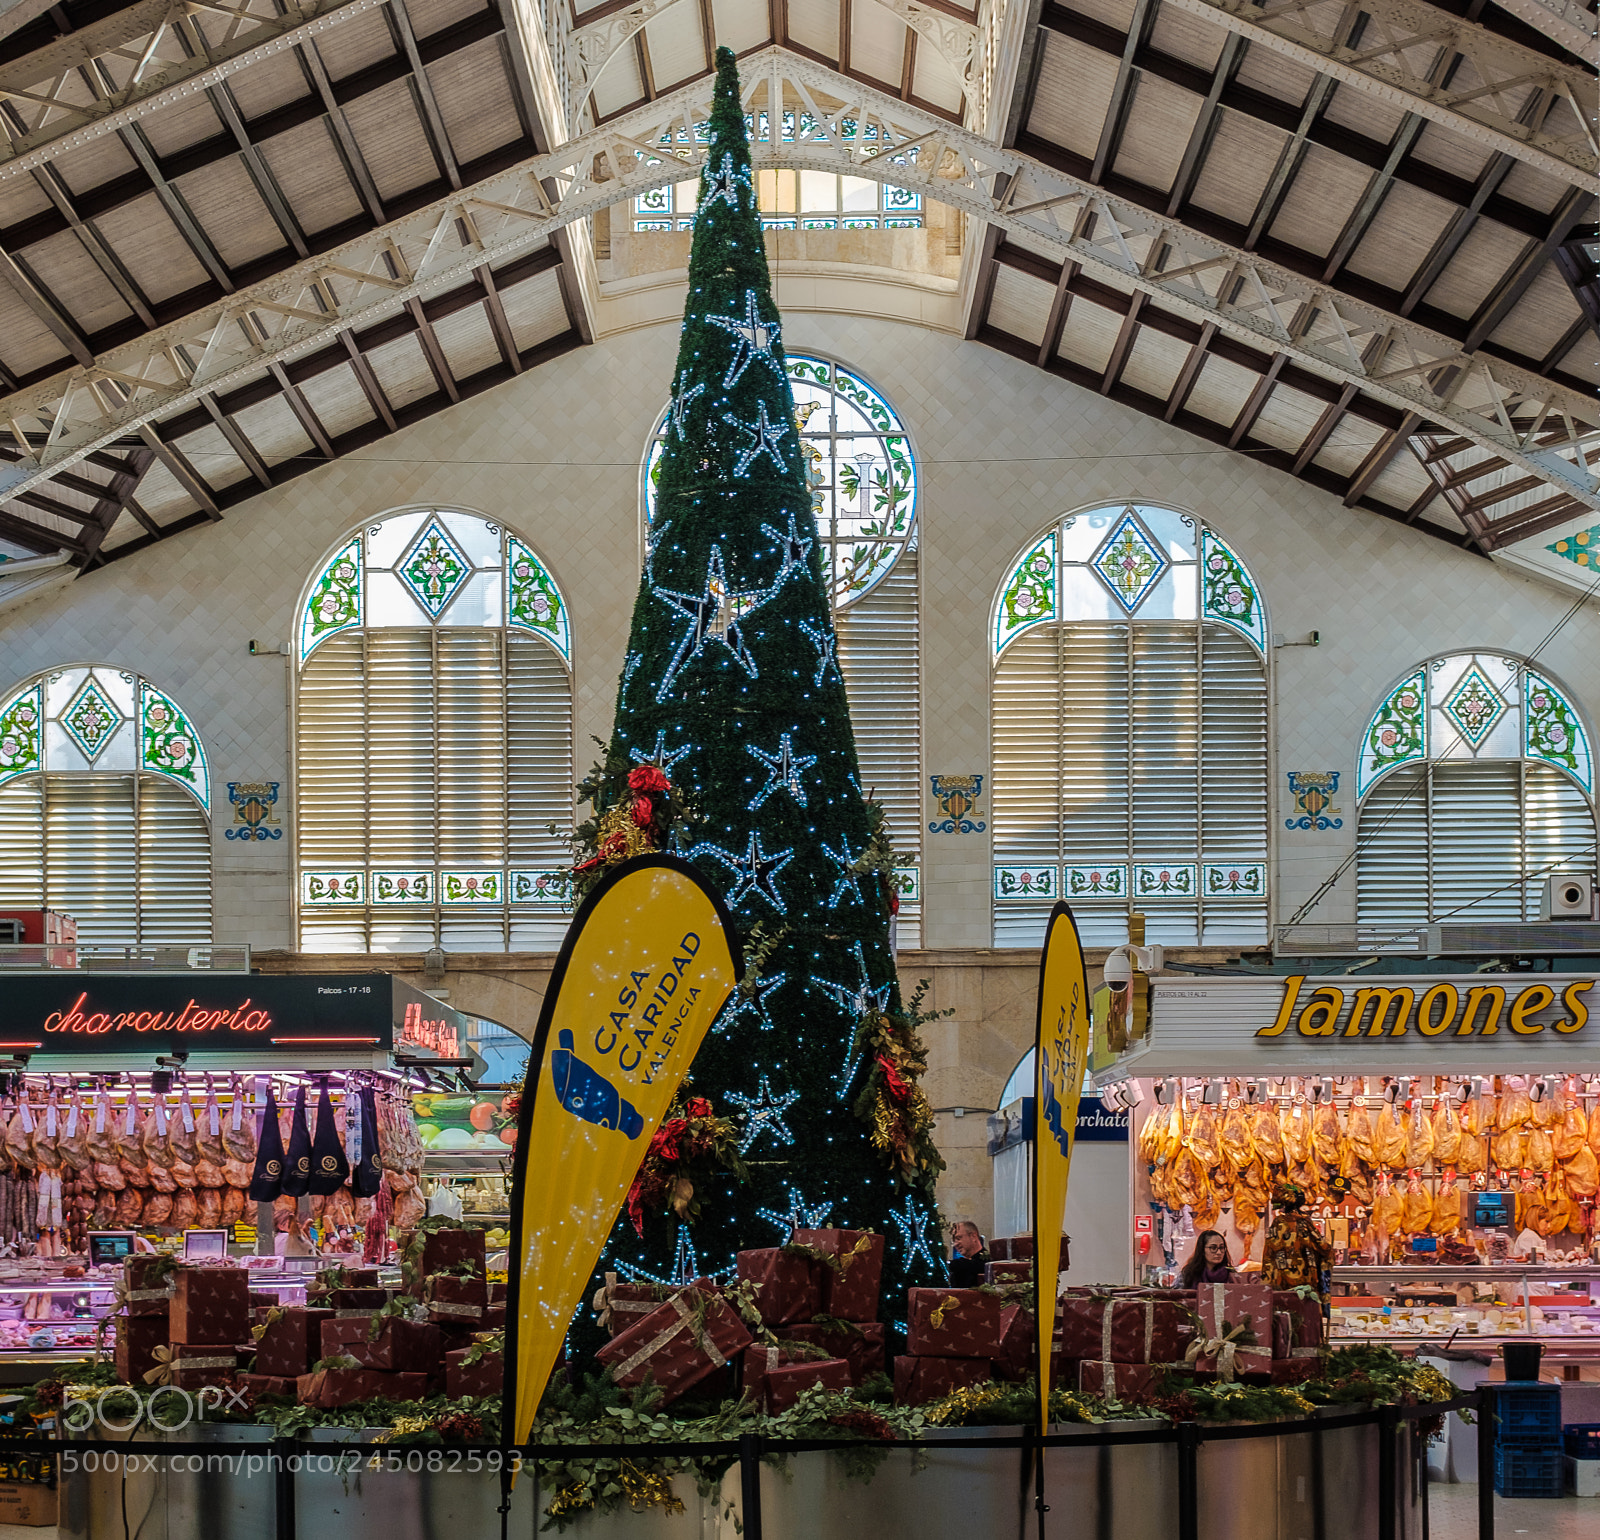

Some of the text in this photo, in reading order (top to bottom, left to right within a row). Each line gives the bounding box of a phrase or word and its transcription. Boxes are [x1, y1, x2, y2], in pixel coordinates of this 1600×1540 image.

[43, 991, 272, 1035] charcutería
[348, 986, 357, 994] 17
[594, 970, 650, 1055] CASA
[619, 931, 701, 1072] CARIDAD
[1253, 974, 1598, 1037] Jamones
[641, 987, 701, 1085] VALENCIA
